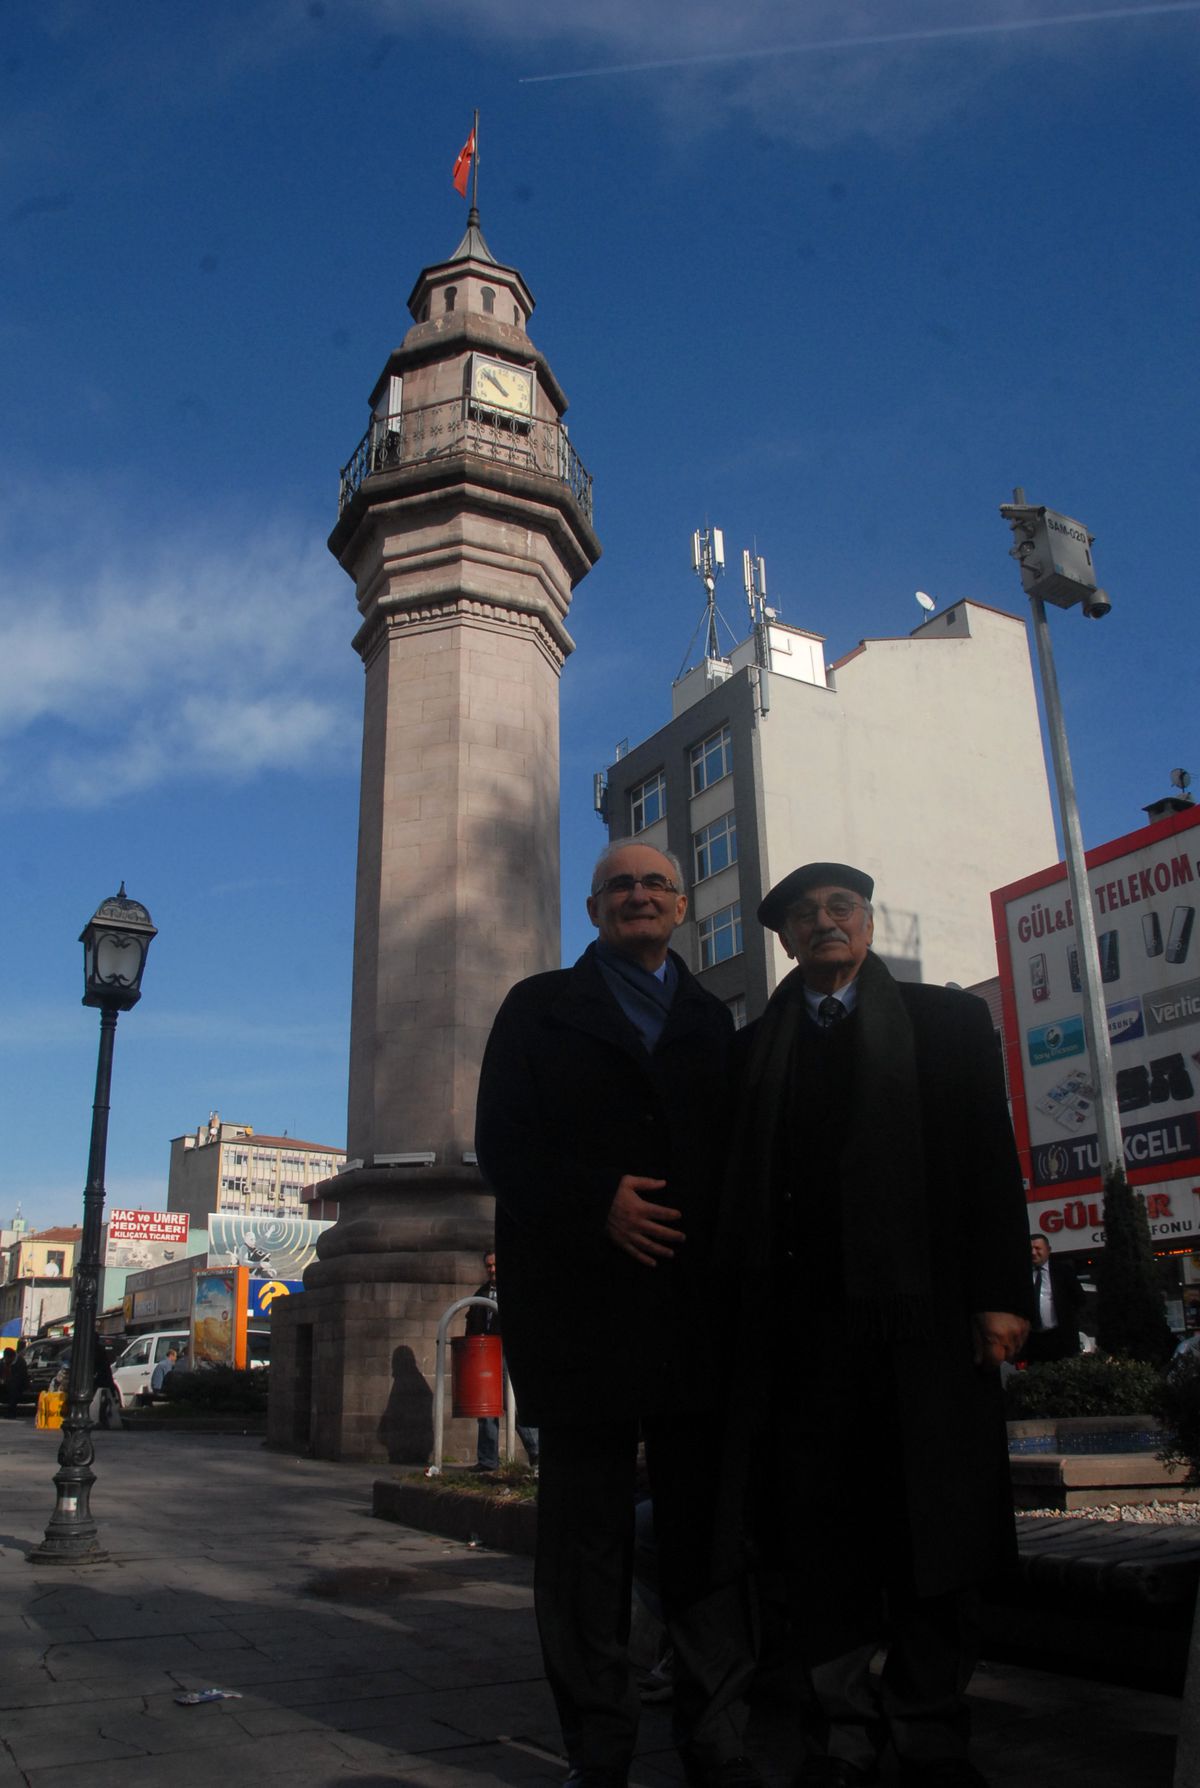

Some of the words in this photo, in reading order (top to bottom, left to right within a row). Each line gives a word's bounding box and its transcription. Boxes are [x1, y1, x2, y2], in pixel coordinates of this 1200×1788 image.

[1095, 854, 1194, 914] TELEKOM
[1073, 1124, 1192, 1171] TUKCELL
[111, 1210, 135, 1222] HAC
[137, 1214, 151, 1223] ve
[153, 1213, 186, 1225] UMRE
